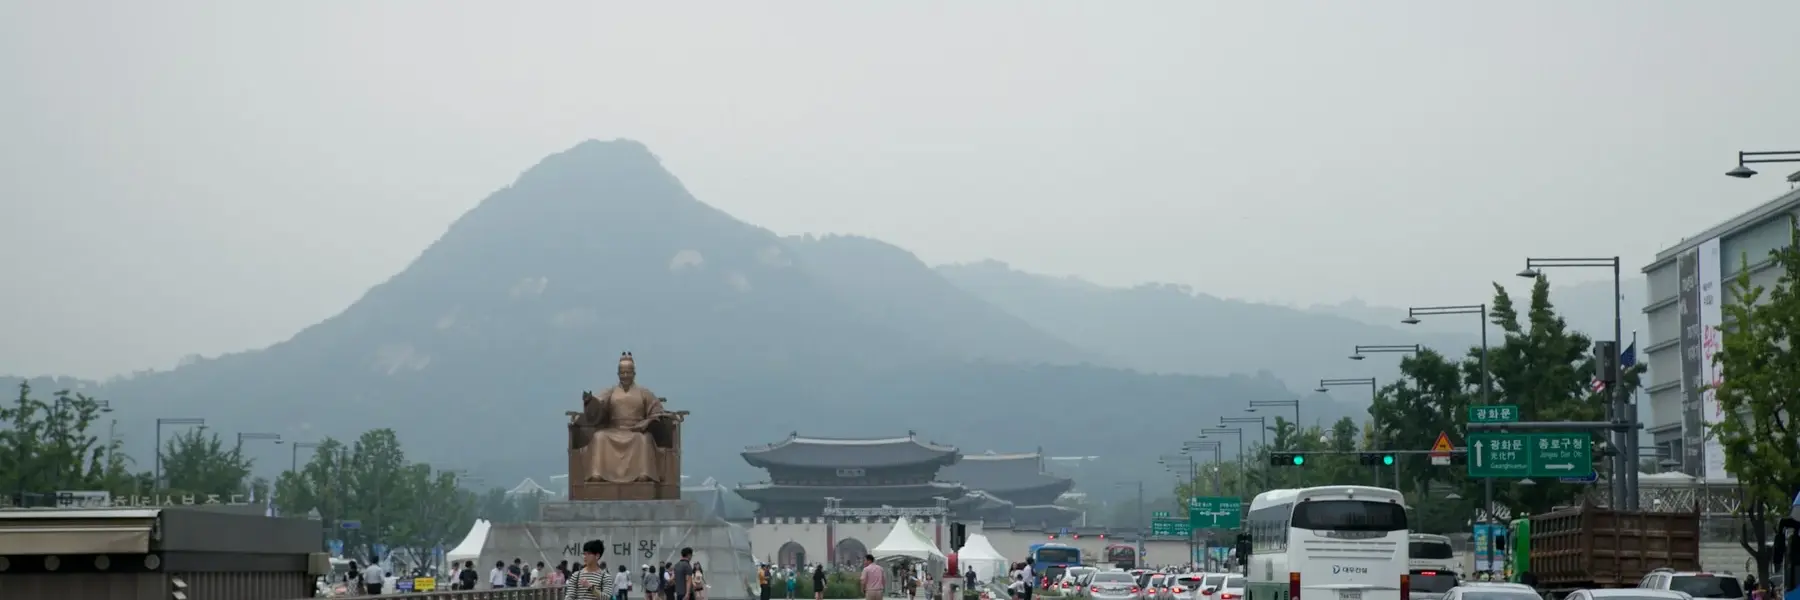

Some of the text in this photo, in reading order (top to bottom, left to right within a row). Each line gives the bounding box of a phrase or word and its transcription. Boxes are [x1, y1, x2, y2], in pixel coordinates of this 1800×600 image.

[1476, 408, 1511, 420] 광화문
[1490, 439, 1522, 451] 광화문
[1538, 438, 1583, 450] 종로구청
[562, 540, 657, 559] 세대왕
